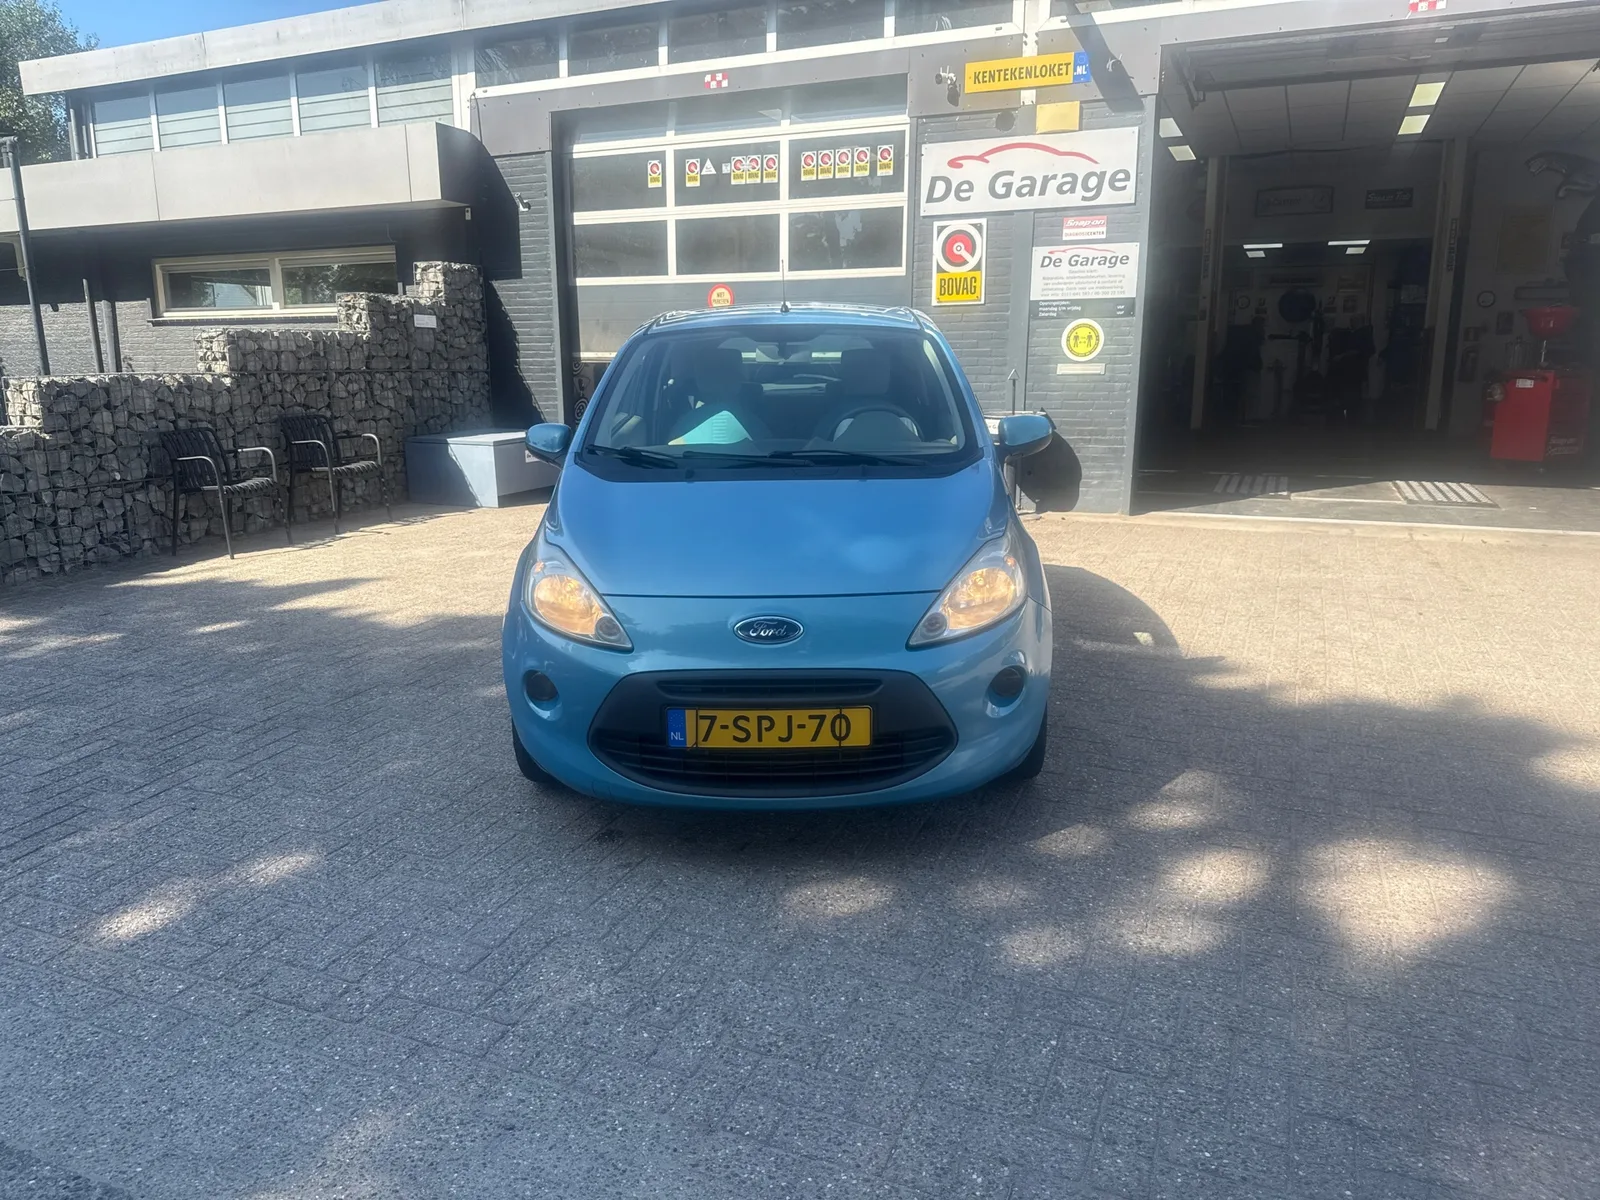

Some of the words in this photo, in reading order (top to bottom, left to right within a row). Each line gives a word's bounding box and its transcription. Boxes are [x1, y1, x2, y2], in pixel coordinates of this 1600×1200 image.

[973, 62, 1072, 85] KENTEKENLOKET
[925, 175, 975, 204] De
[987, 168, 1131, 202] Garage
[1040, 255, 1063, 268] De
[1068, 254, 1130, 268] Garage
[939, 276, 977, 296] BOVAG
[749, 620, 787, 637] Ford
[670, 731, 684, 741] NL
[698, 712, 852, 743] 7-SPJ-70
